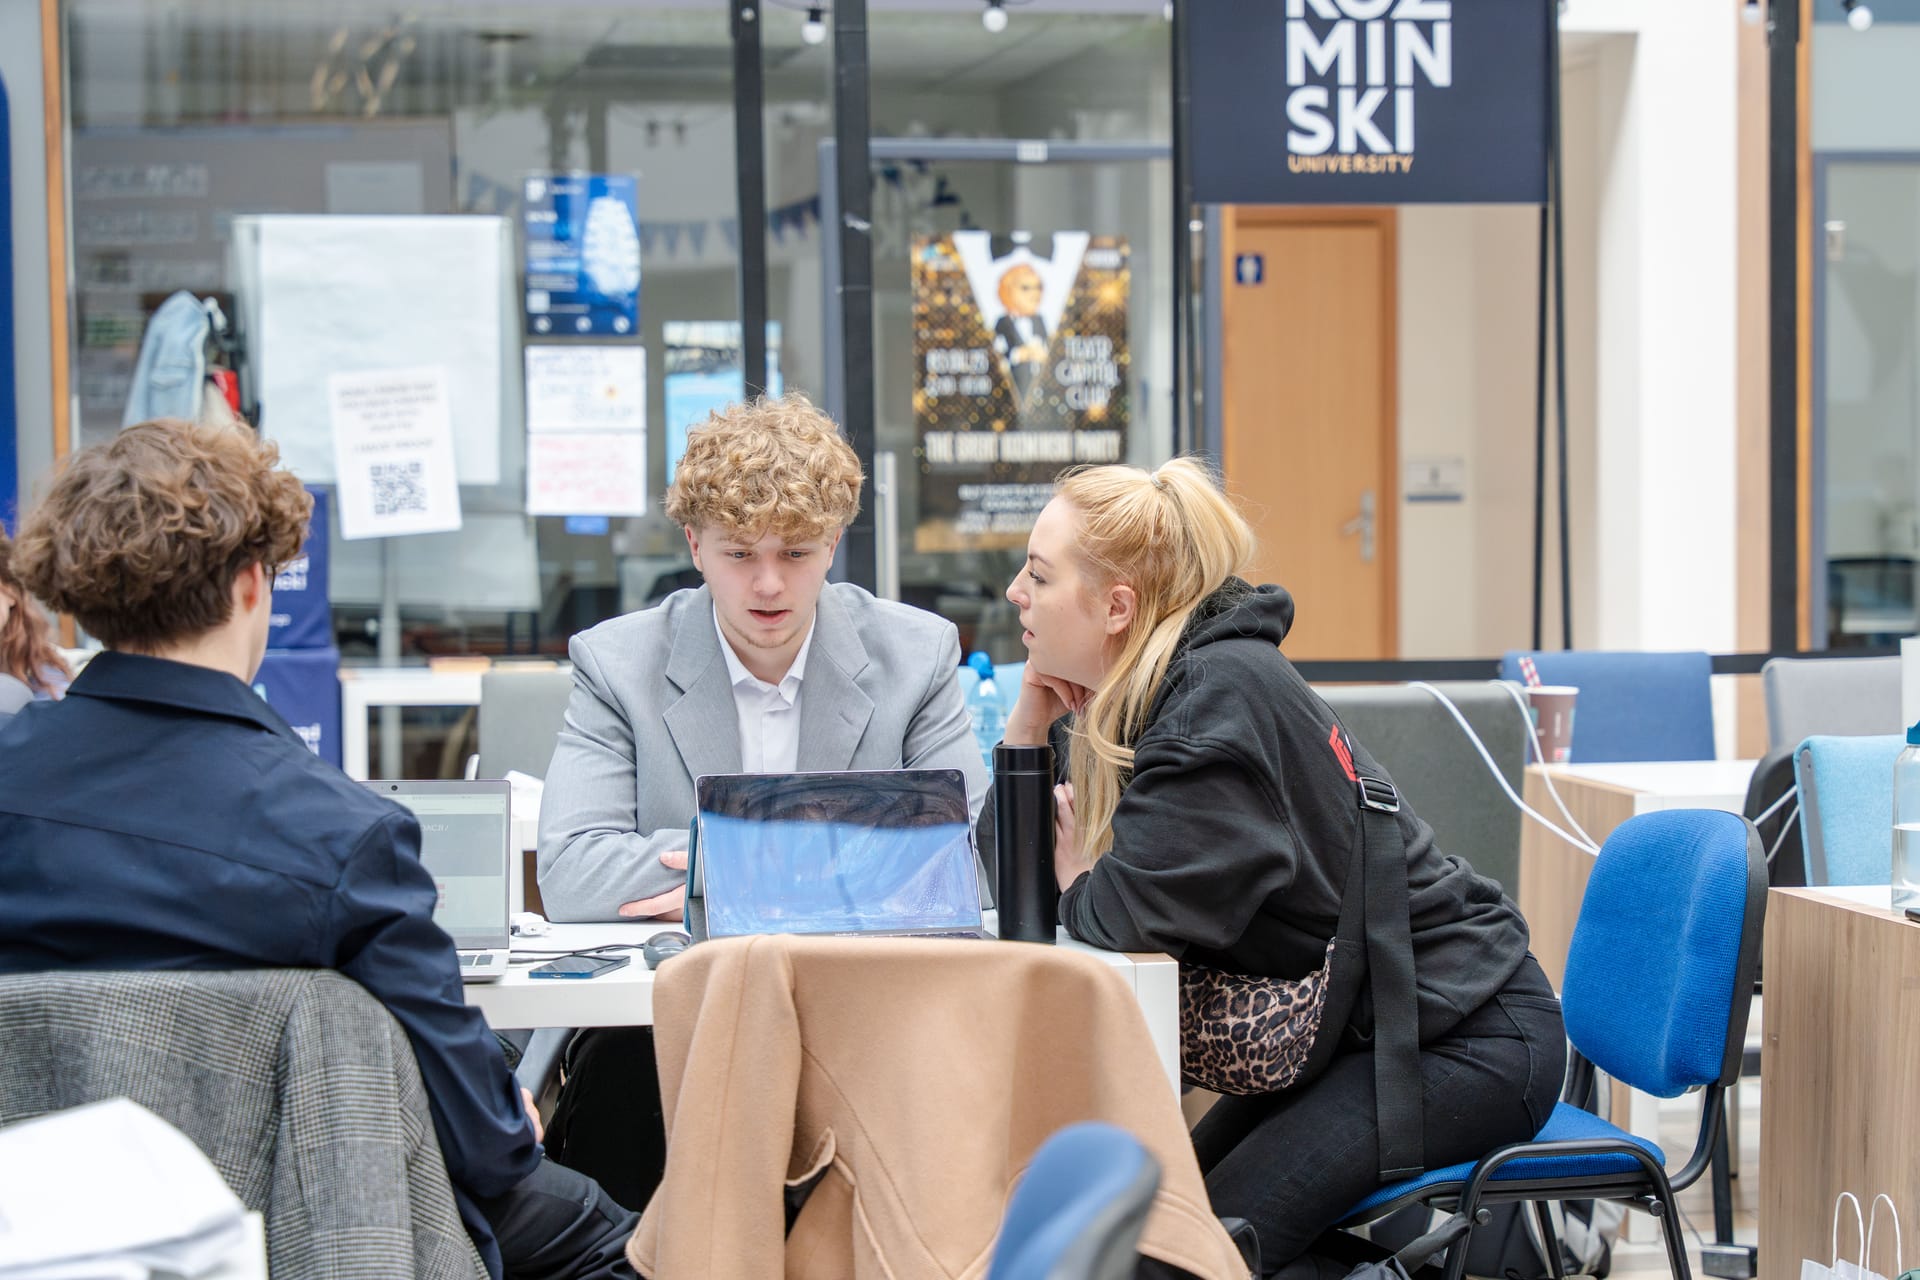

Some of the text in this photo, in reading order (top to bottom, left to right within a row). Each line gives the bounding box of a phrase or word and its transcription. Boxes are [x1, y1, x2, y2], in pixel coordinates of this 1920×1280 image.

[1286, 19, 1452, 87] MIN
[1286, 85, 1415, 156] SKI
[1287, 154, 1414, 174] UNIVERSITY
